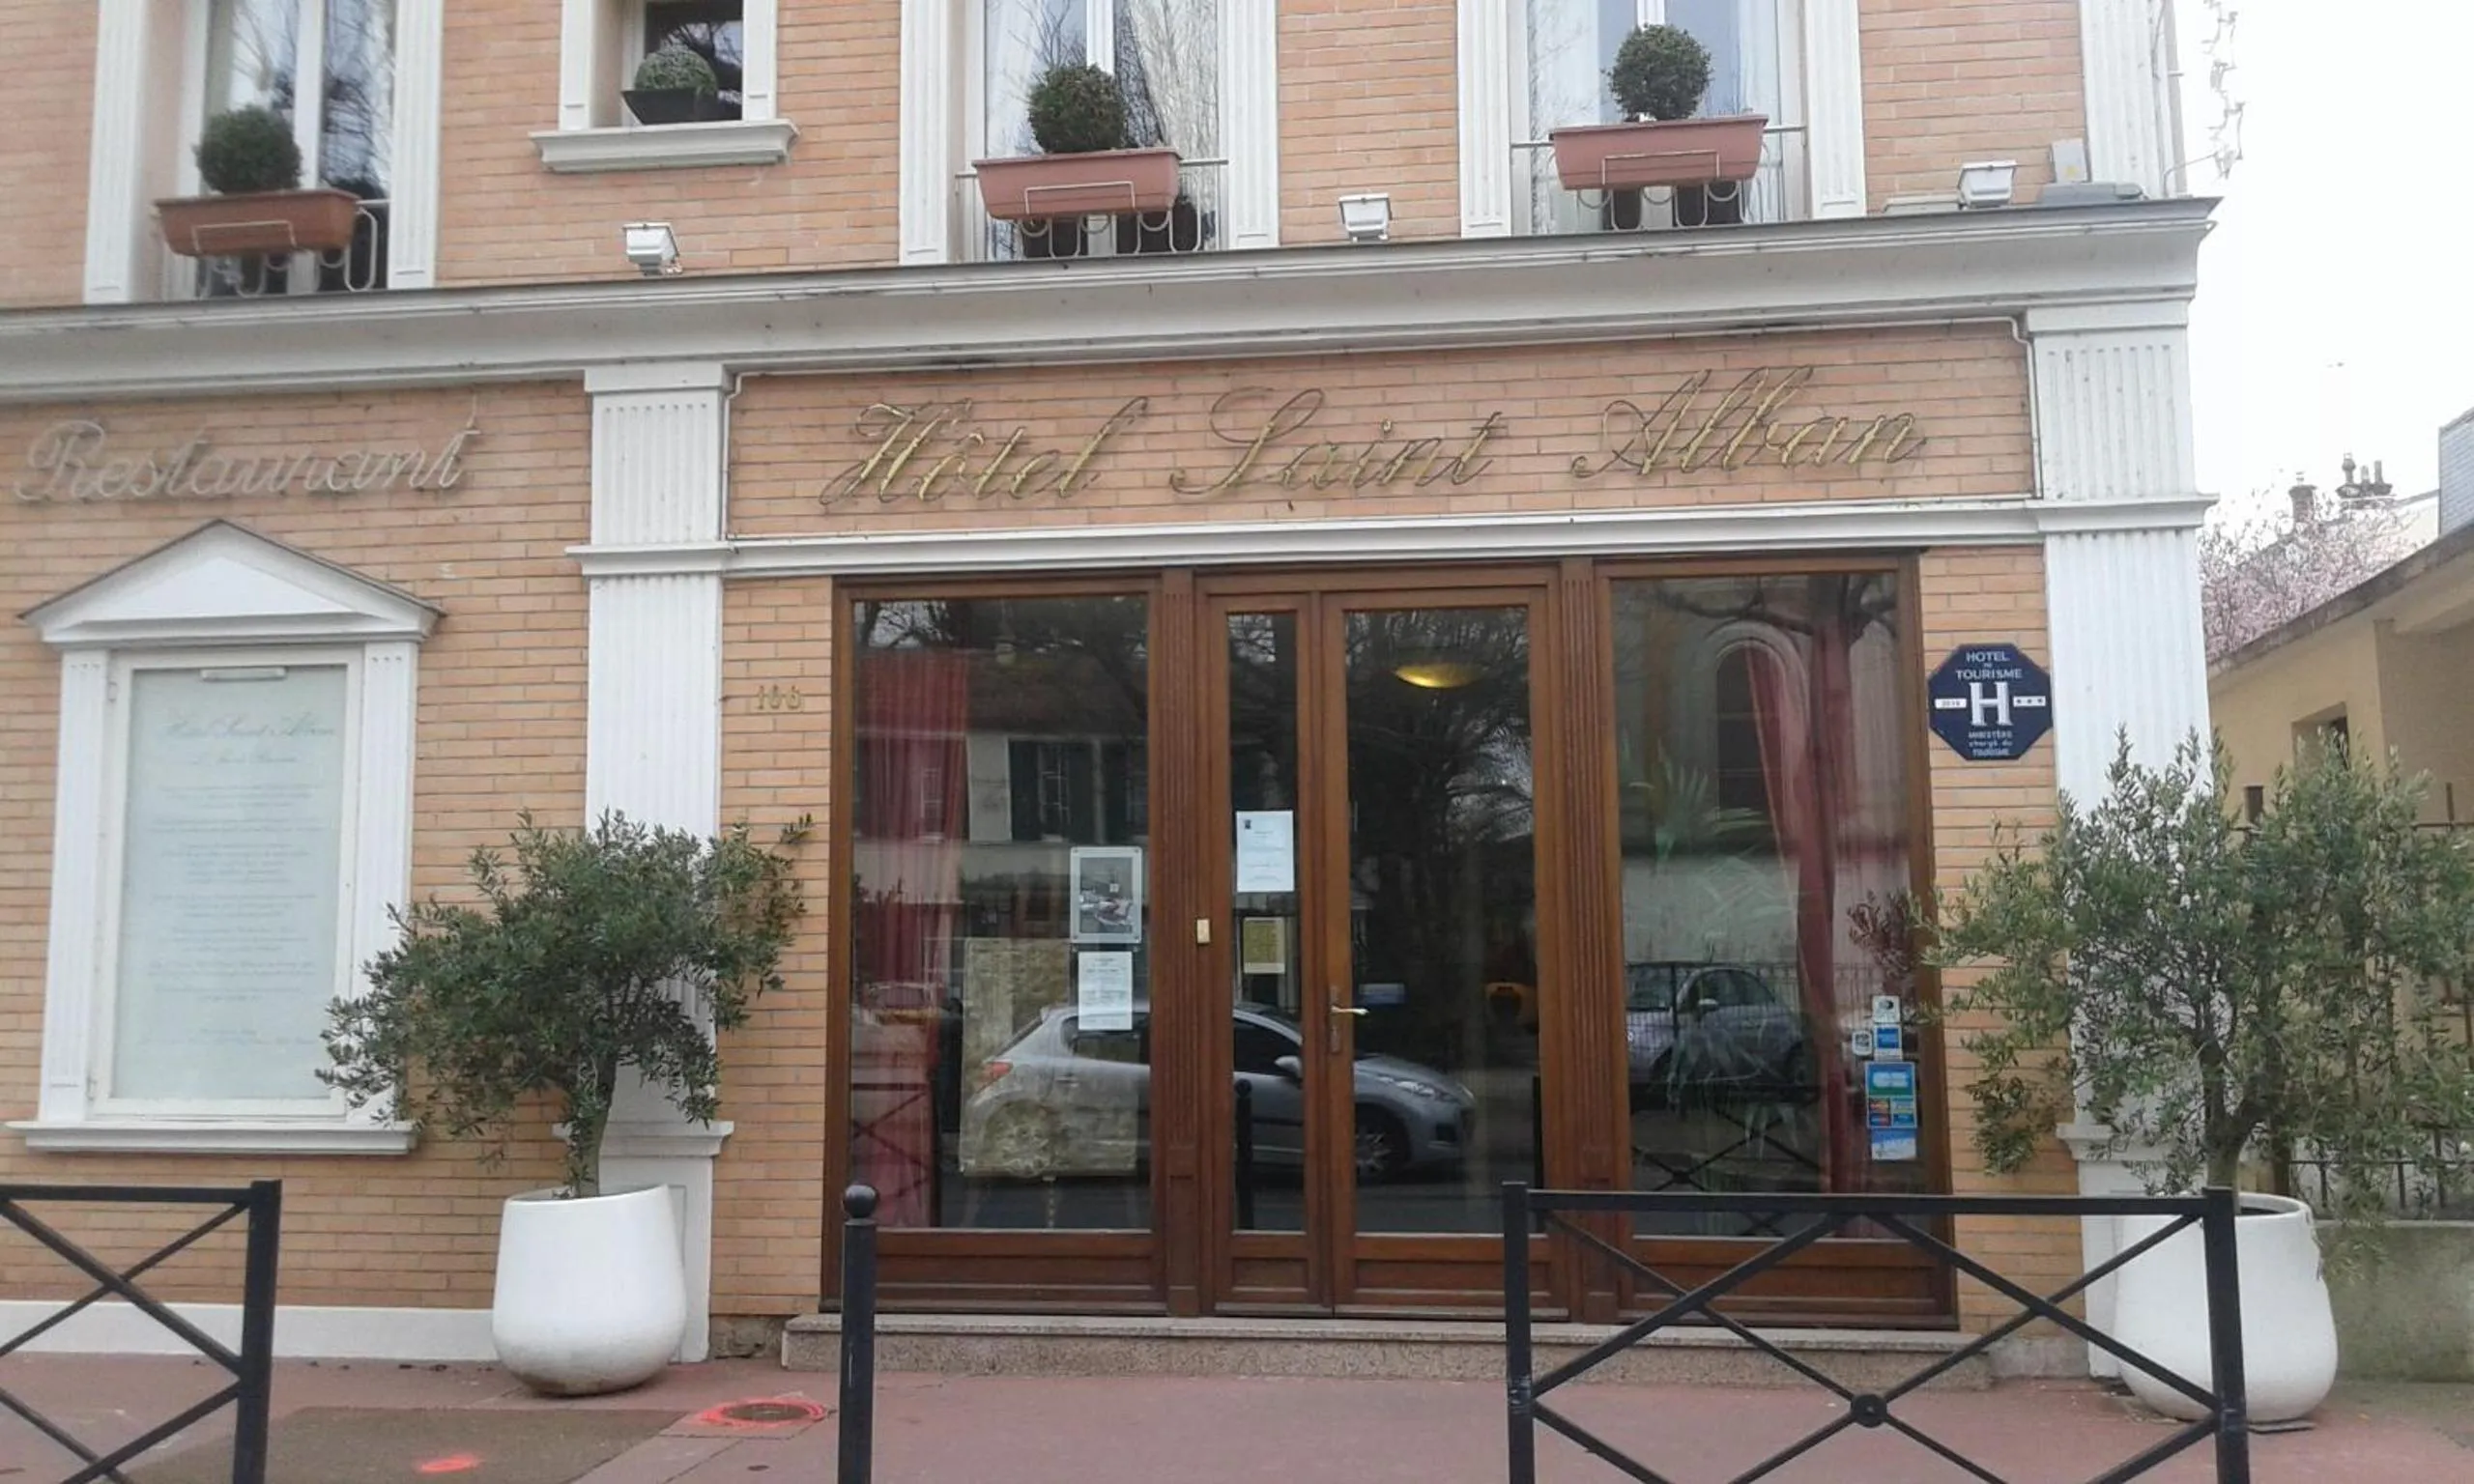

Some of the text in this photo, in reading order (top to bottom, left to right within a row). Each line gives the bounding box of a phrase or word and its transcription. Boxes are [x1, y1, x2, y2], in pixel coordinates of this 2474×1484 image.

[1169, 388, 1508, 496] Saint
[1571, 364, 1928, 479] Alban
[14, 412, 481, 500] Restaurant
[1955, 669, 2023, 680] TOURISME
[1966, 650, 2010, 663] HOTEL
[1970, 682, 2012, 726] H
